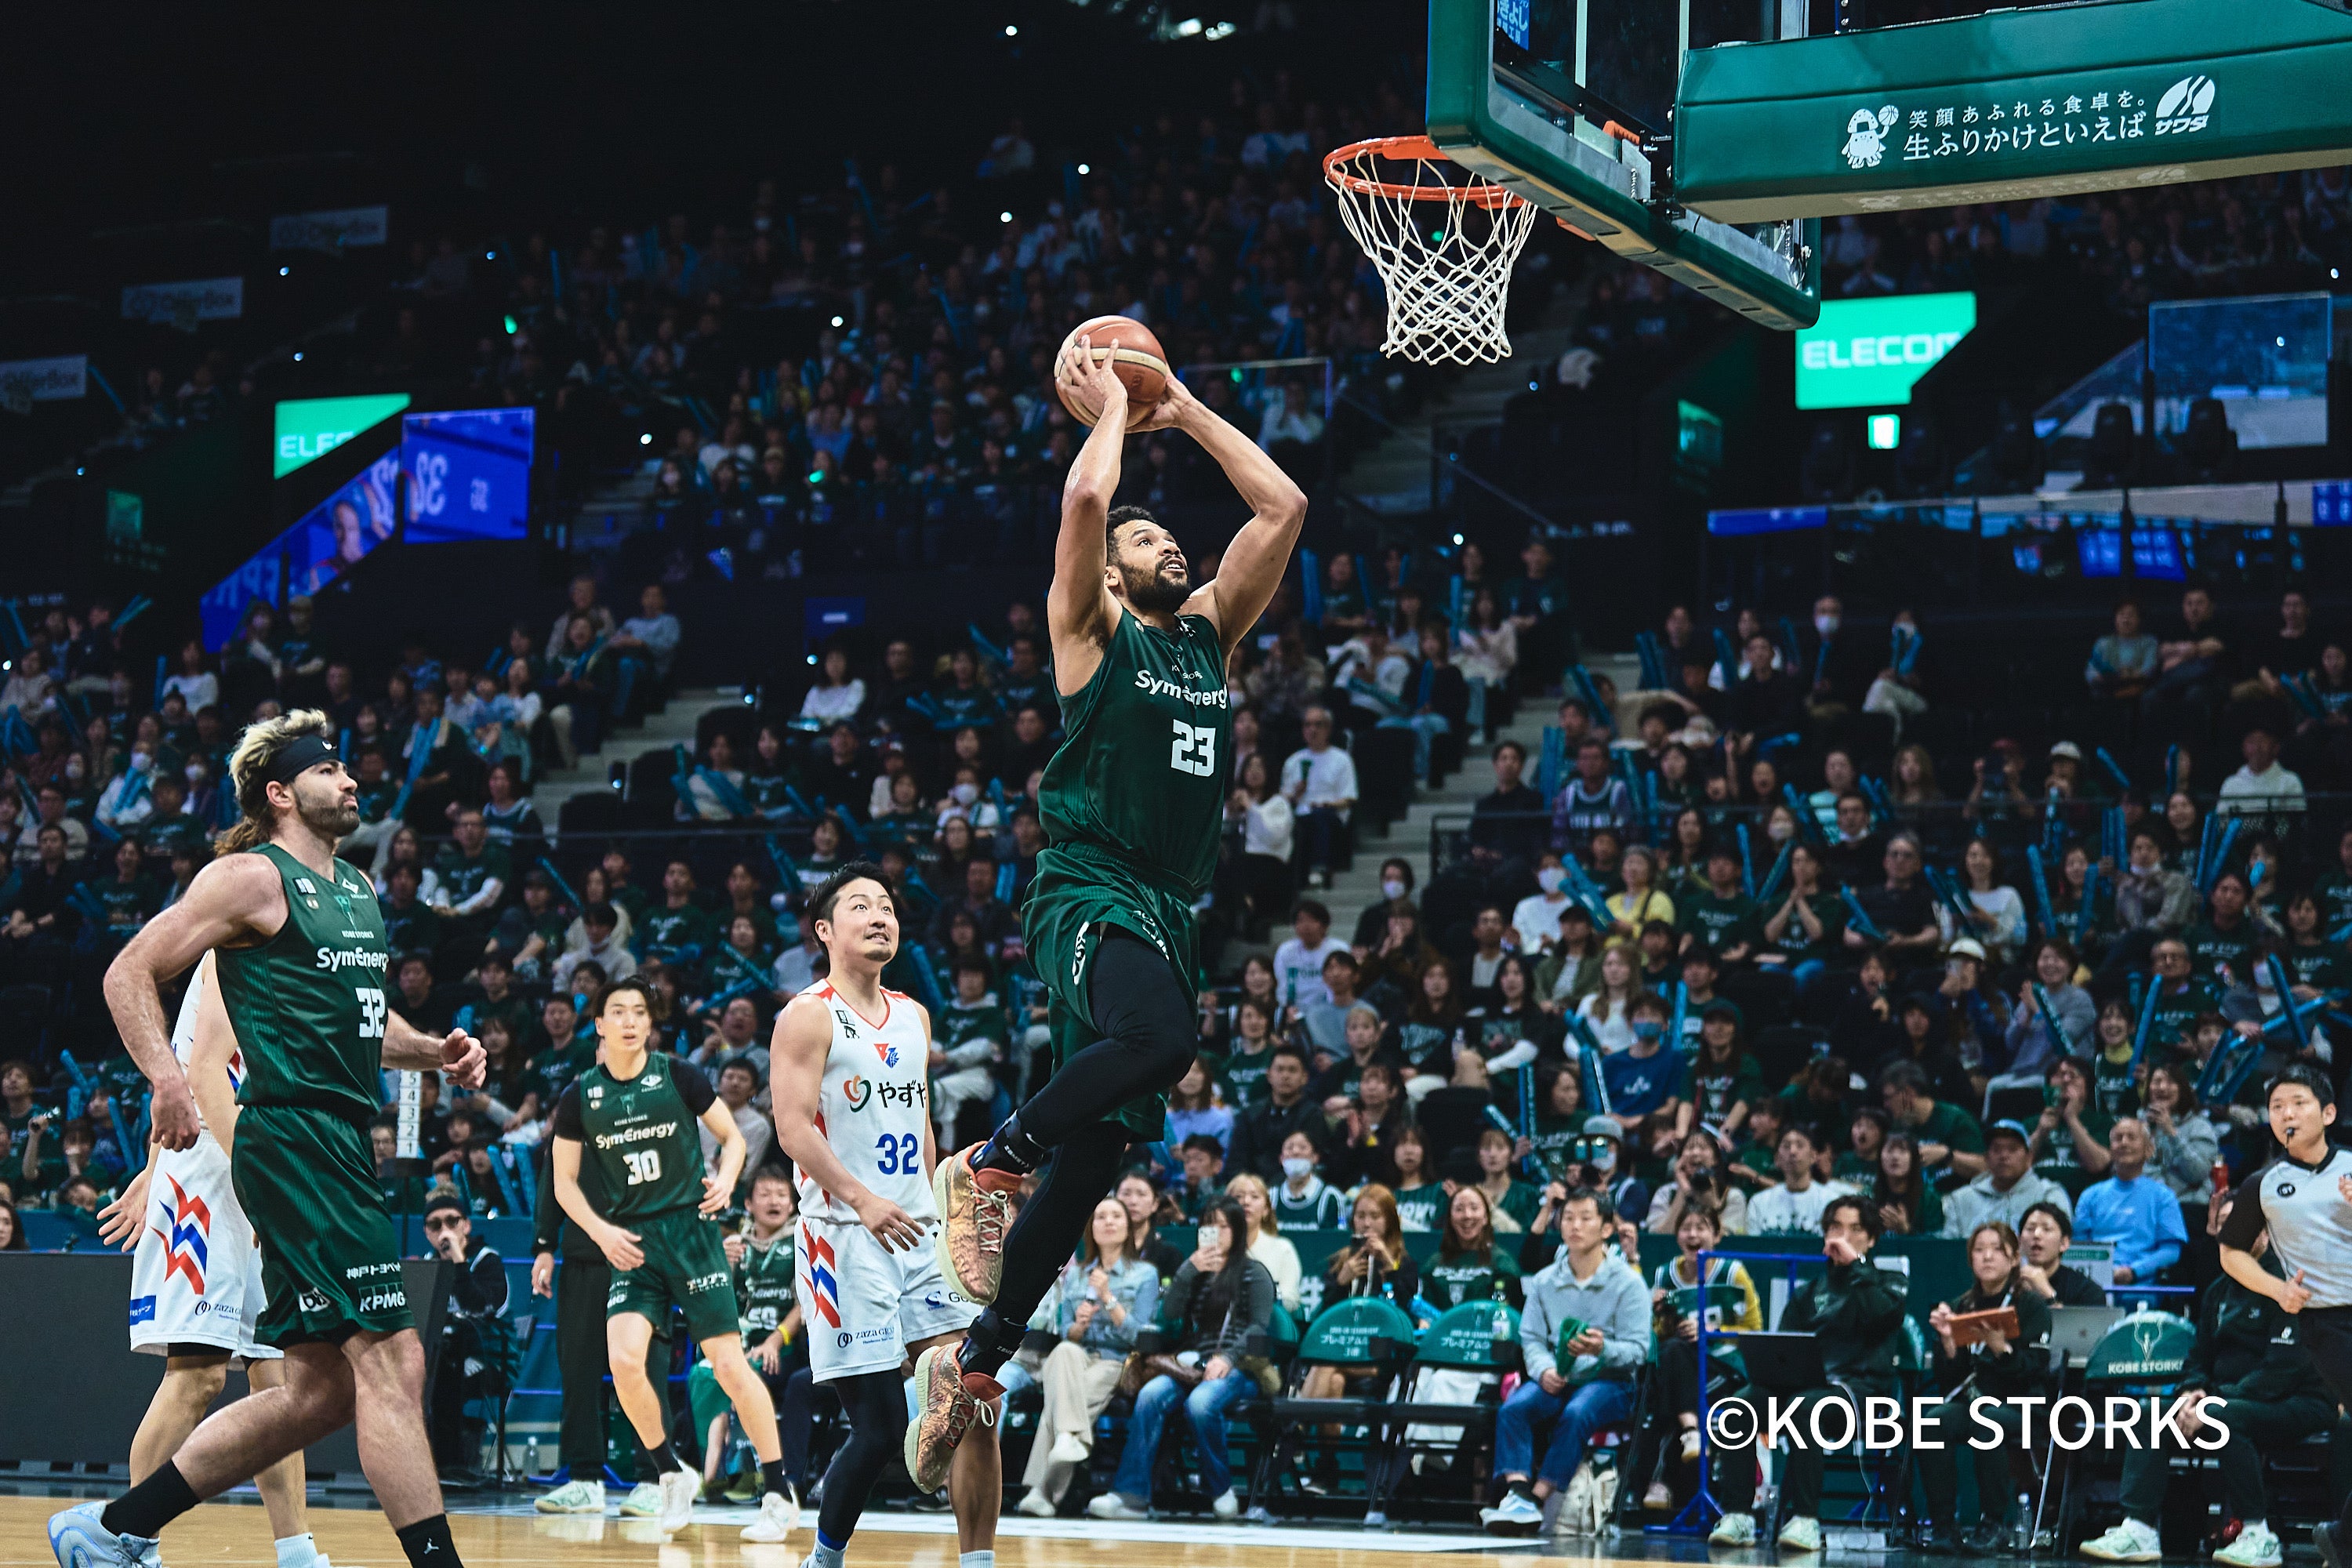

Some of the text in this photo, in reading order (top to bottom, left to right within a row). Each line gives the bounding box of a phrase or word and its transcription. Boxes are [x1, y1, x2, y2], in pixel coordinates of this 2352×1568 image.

[1909, 90, 2145, 129] 笑顔あふれる食卓を。
[1903, 111, 2147, 161] 生ふりかけといえば
[2154, 114, 2209, 136] サワダ
[1134, 670, 1228, 710] SymEnerg
[1171, 719, 1215, 777] 23
[316, 946, 389, 973] SymEnerg
[355, 987, 386, 1038] 32
[408, 1091, 415, 1101] 4
[408, 1108, 415, 1120] 3
[407, 1124, 414, 1137] 2
[596, 1122, 677, 1149] SymEnergy
[407, 1142, 412, 1153] 1
[875, 1133, 919, 1175] 32
[622, 1149, 661, 1185] 30
[359, 1291, 406, 1312] KPMG
[2107, 1363, 2140, 1374] KOBE
